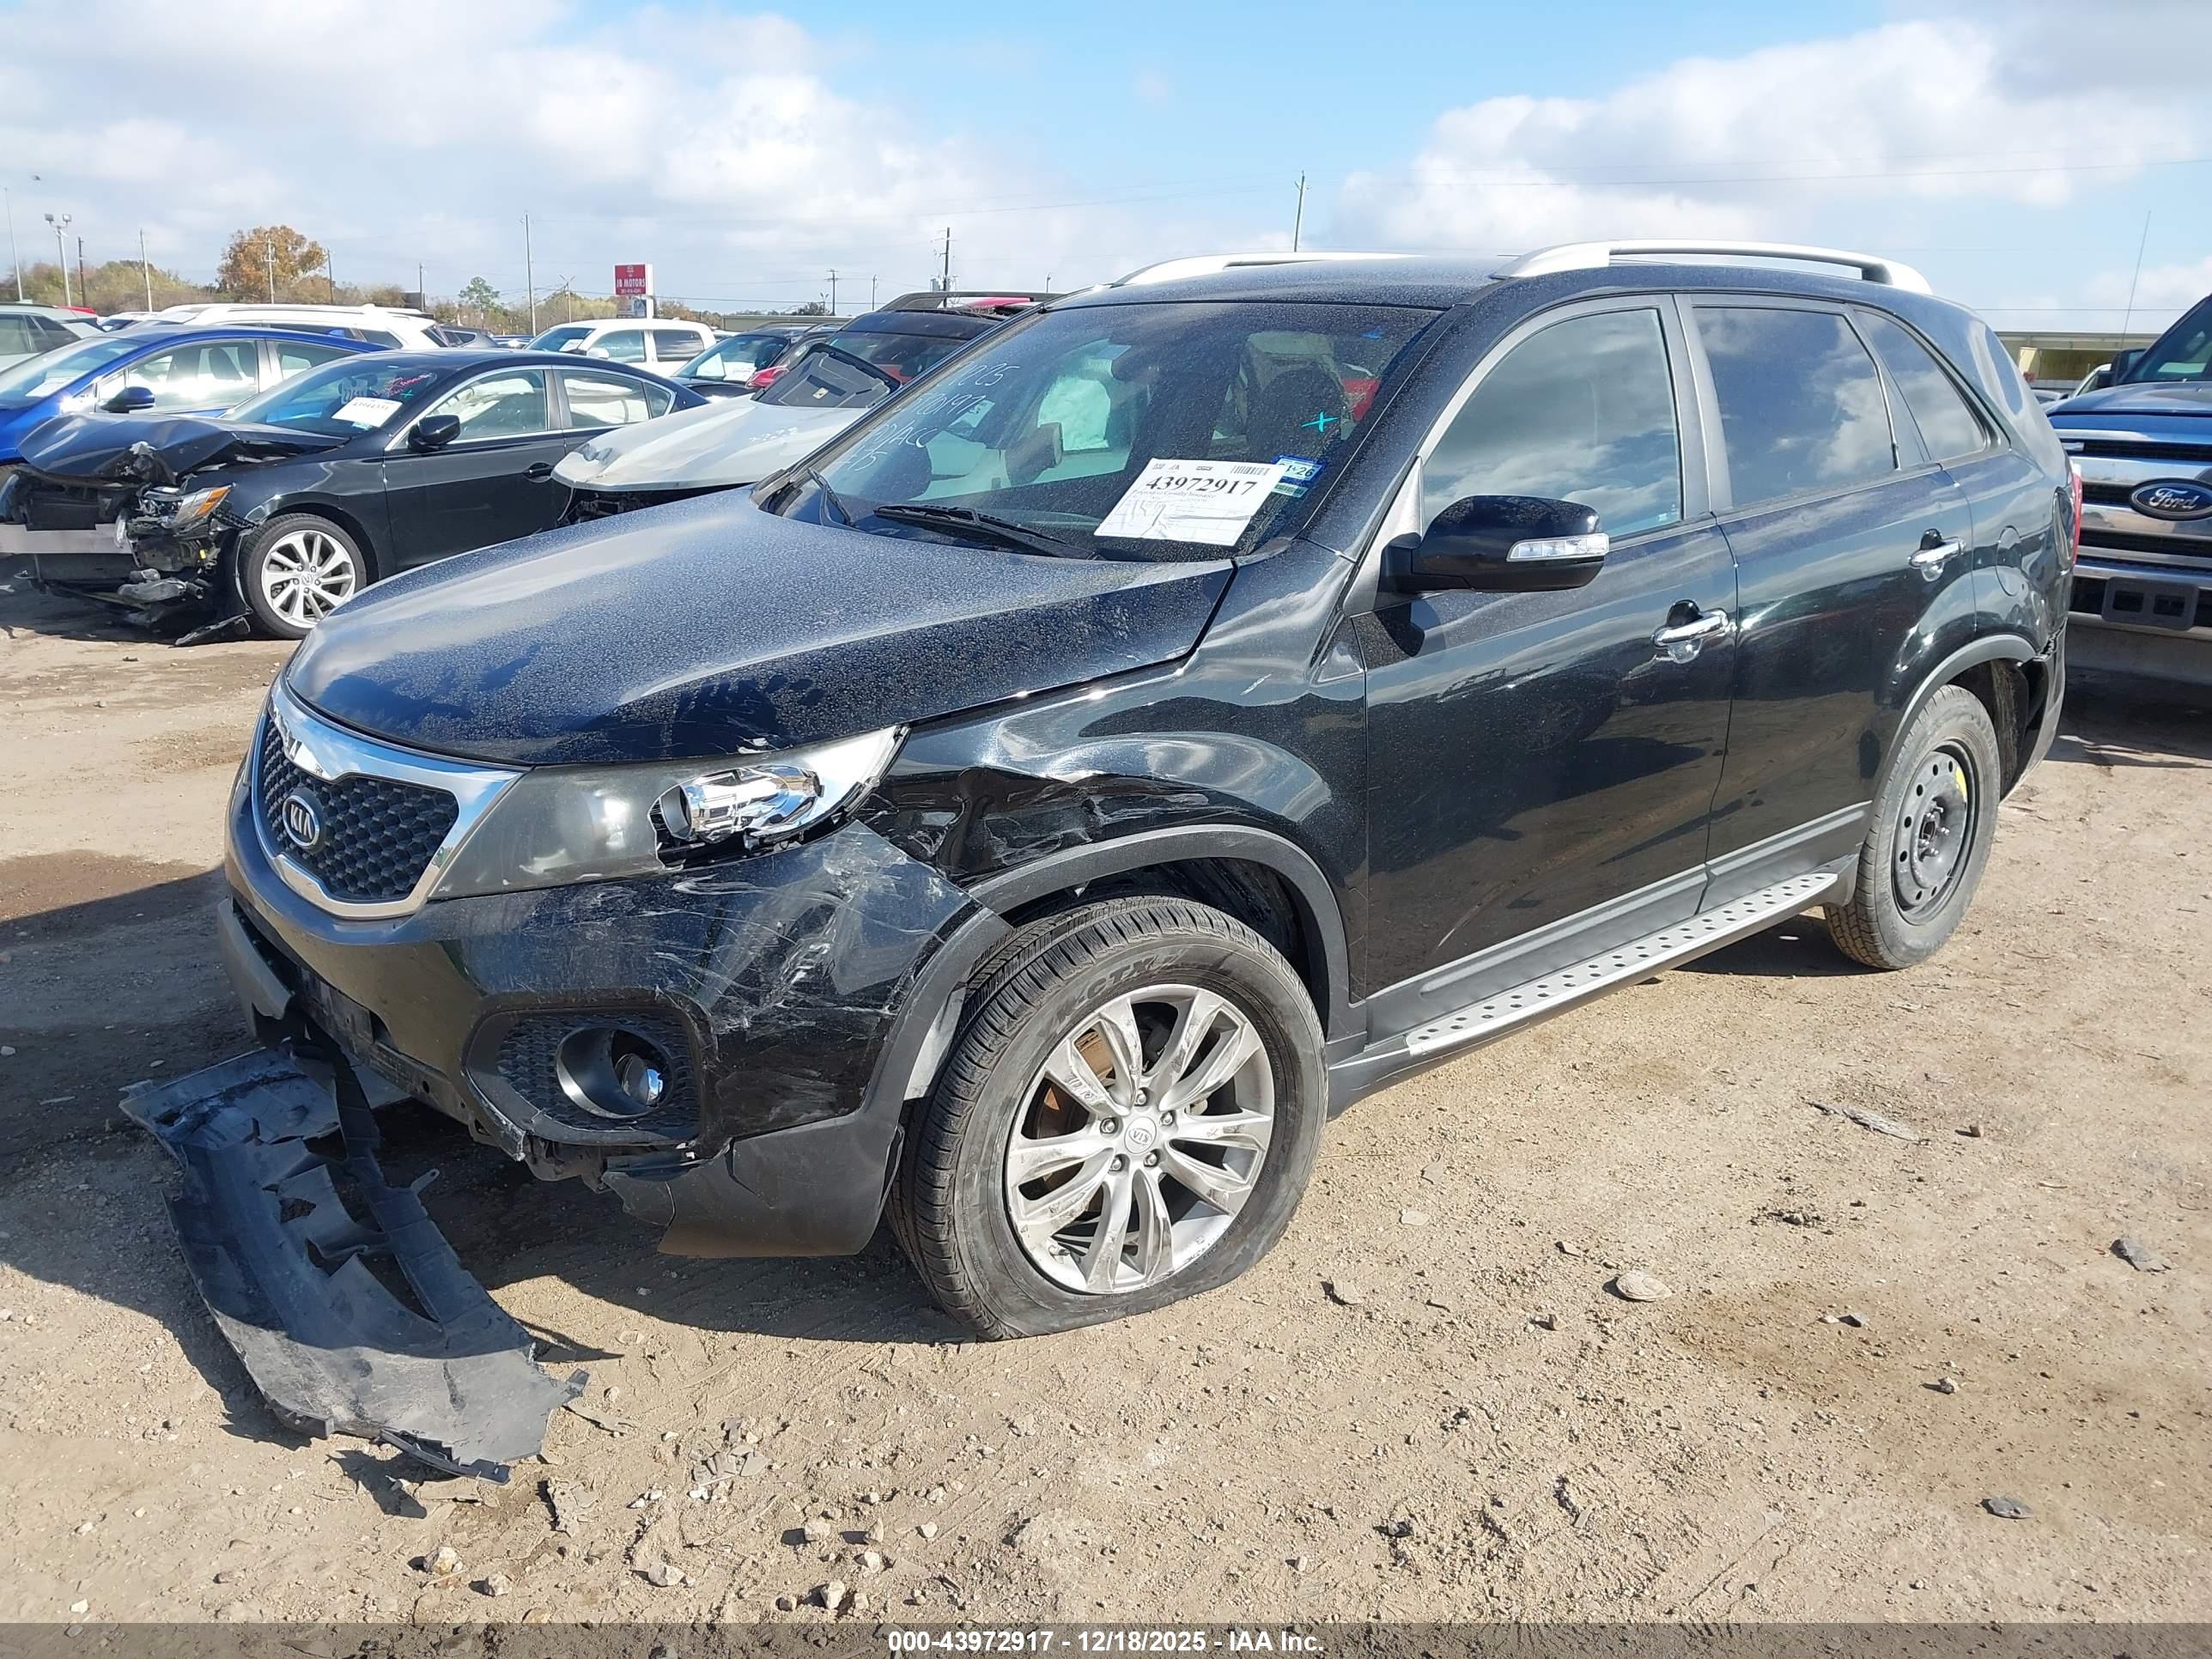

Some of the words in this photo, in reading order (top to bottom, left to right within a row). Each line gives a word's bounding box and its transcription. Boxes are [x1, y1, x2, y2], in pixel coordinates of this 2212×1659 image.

[623, 278, 646, 288] MOTORS
[1295, 466, 1316, 477] 26
[1146, 476, 1258, 495] 43972917
[2149, 488, 2200, 509] Ford
[290, 804, 313, 840] KIA
